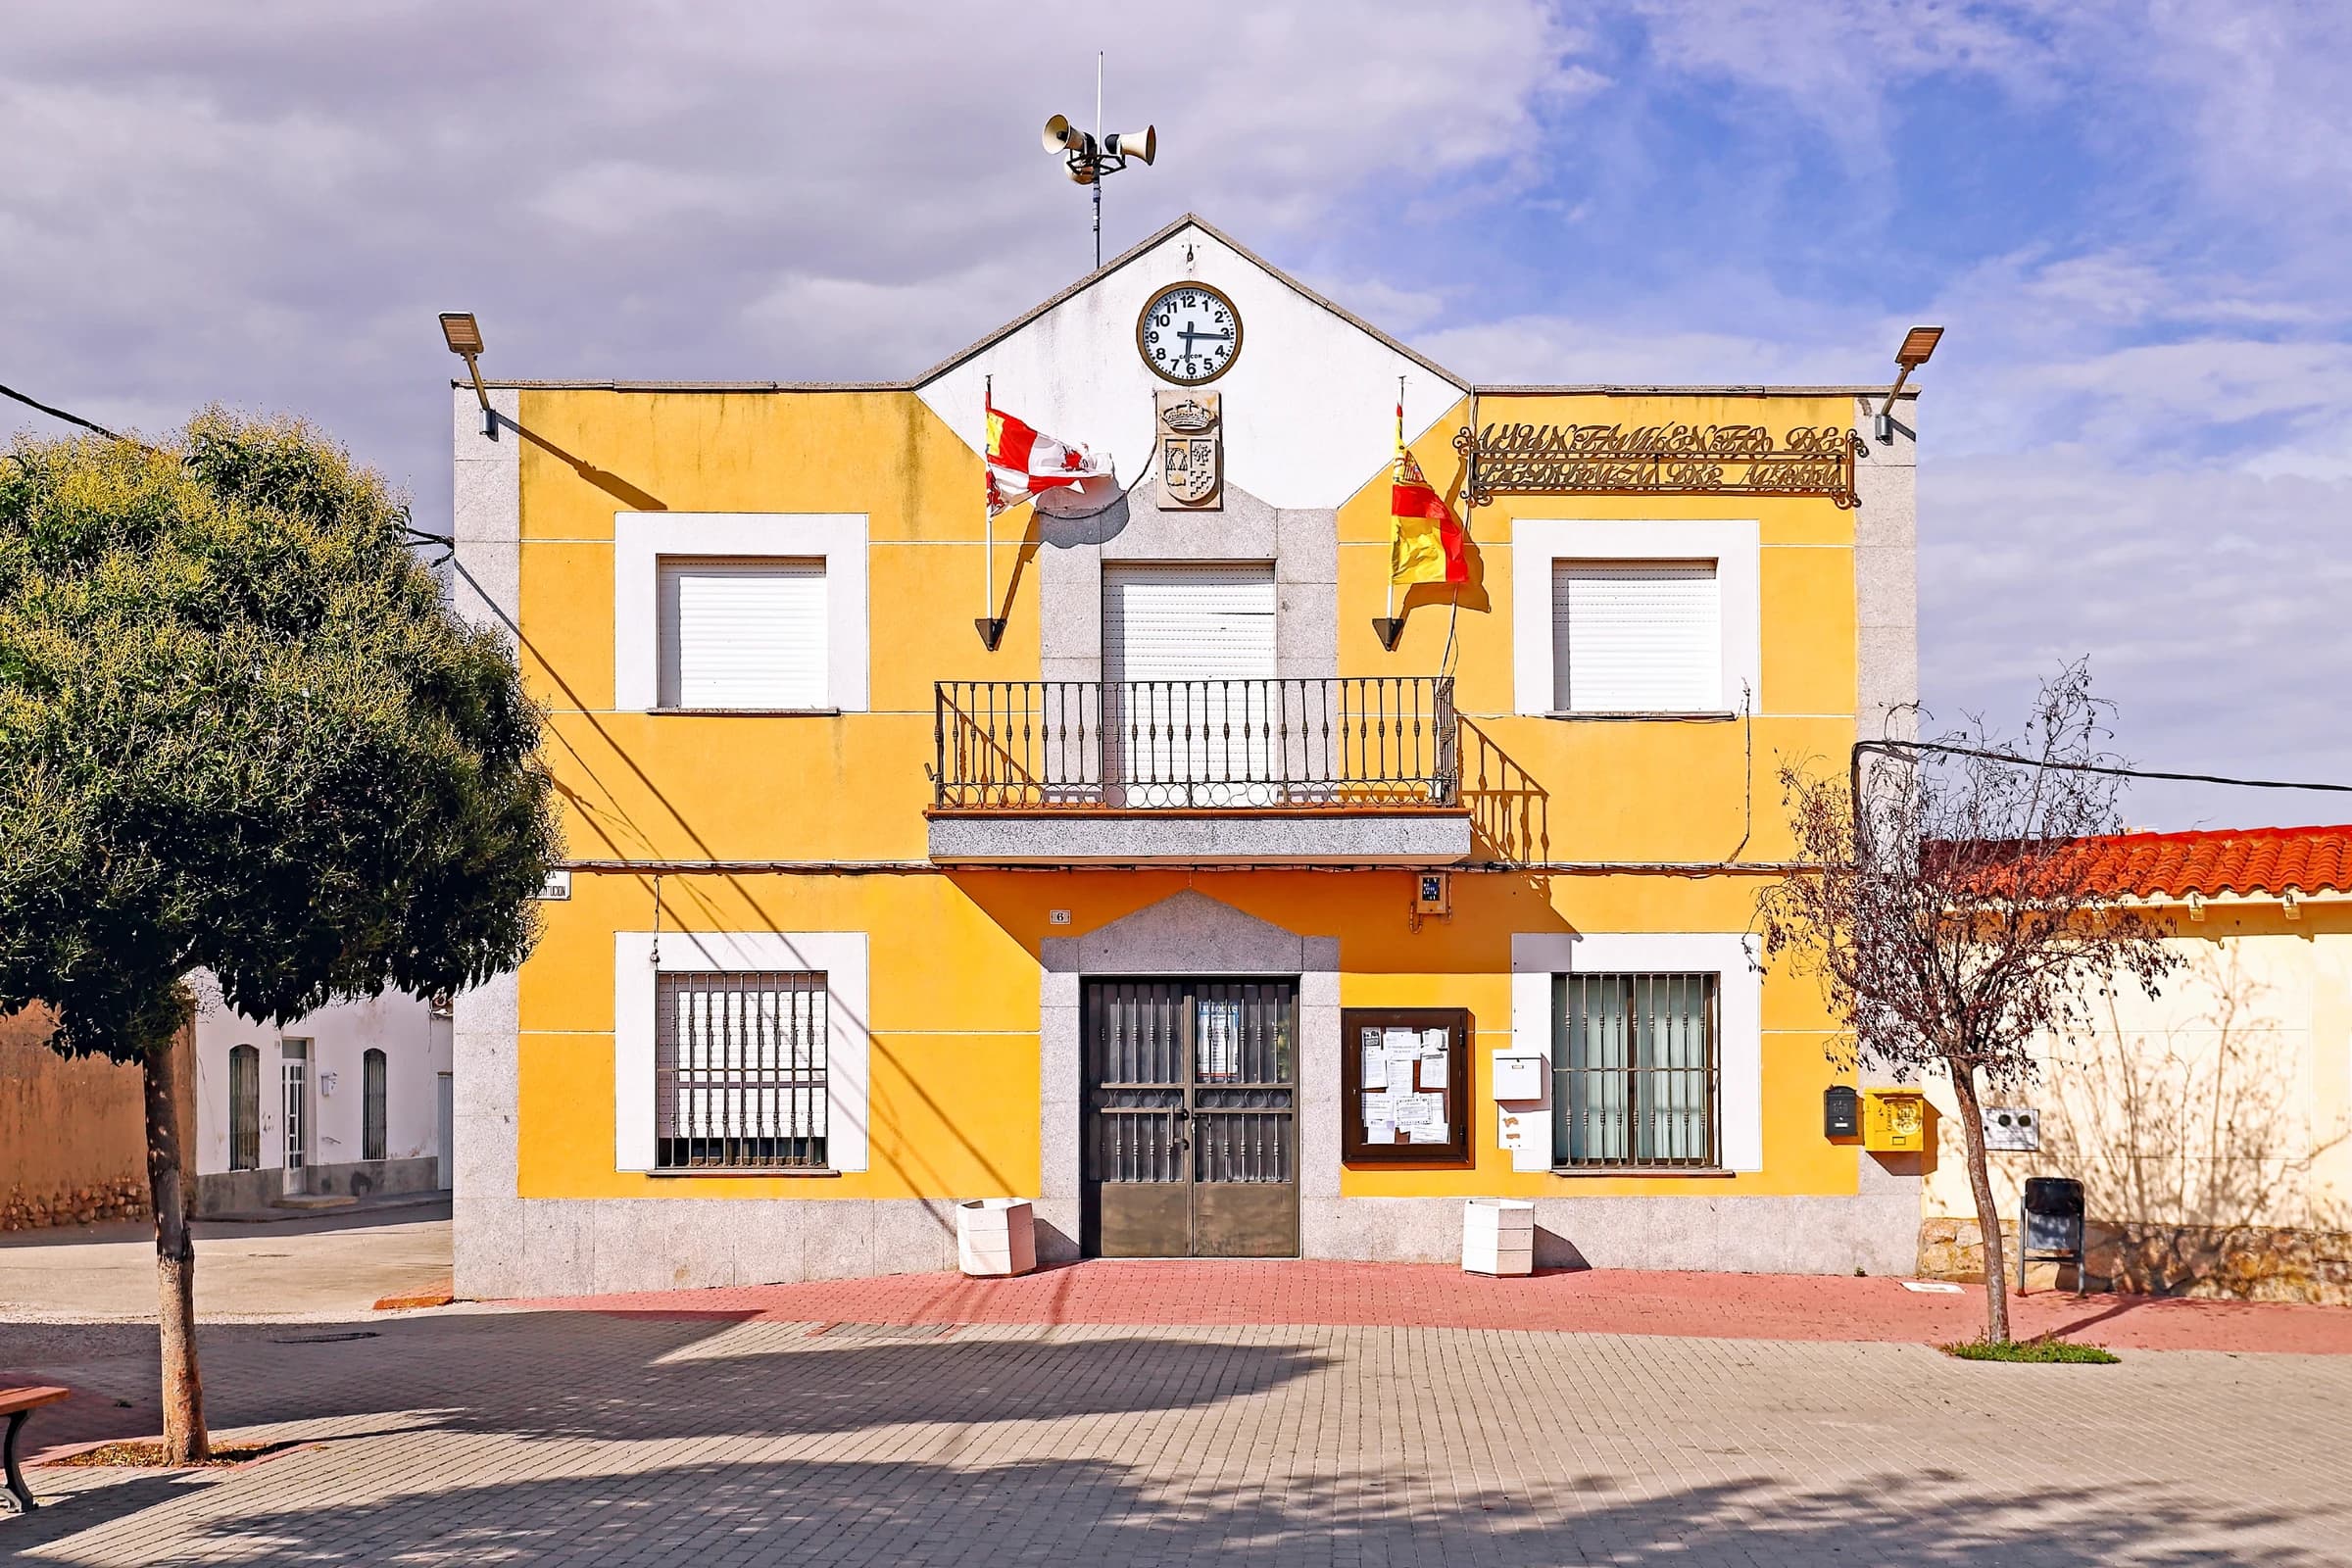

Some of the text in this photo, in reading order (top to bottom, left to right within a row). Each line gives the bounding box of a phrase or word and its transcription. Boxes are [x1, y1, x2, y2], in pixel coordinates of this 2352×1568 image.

[1164, 301, 1177, 314] 11
[1180, 295, 1196, 308] 12
[1201, 299, 1208, 312] 1
[1153, 314, 1170, 327] 10
[1214, 311, 1224, 323] 2
[1149, 331, 1159, 344] 9
[1156, 347, 1166, 361] 8
[1214, 345, 1225, 358] 4
[1170, 359, 1180, 371] 7
[1186, 363, 1197, 375] 6
[1203, 358, 1213, 370] 5
[1476, 421, 1845, 455] AYUNTAMIENTO DE
[1665, 461, 1724, 486] DE
[1056, 912, 1064, 921] 6
